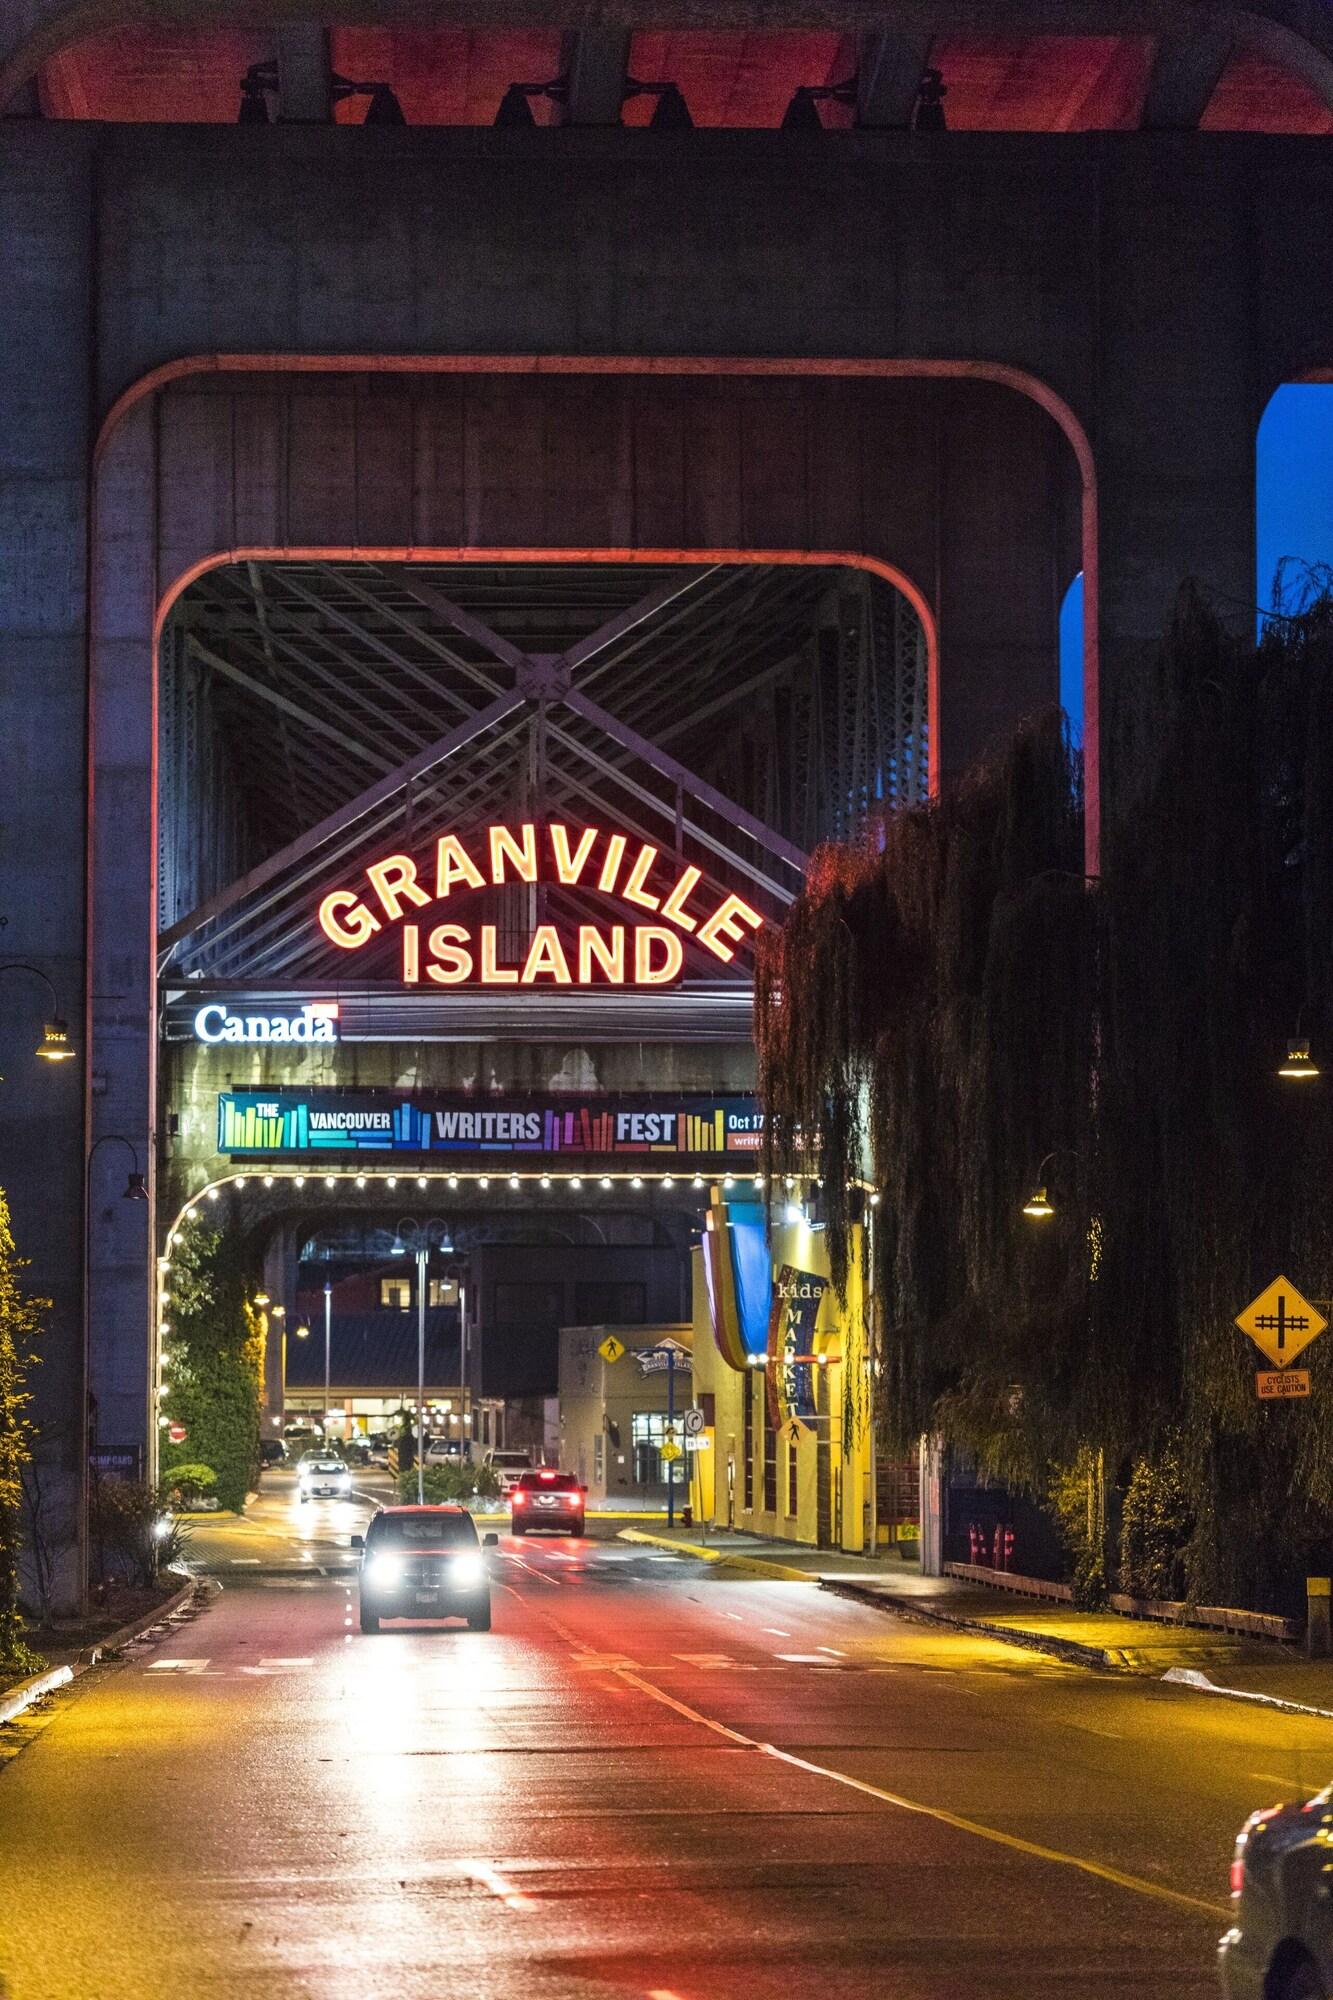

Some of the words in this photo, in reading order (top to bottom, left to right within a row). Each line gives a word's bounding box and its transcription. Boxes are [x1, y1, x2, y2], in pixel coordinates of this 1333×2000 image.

[318, 823, 765, 964] GRANVILLE
[402, 924, 683, 985] ISLAND
[194, 1005, 338, 1044] Canada
[256, 1103, 279, 1118] THE
[309, 1112, 391, 1130] VANCOUVER
[436, 1111, 541, 1140] WRITERS
[616, 1113, 676, 1142] FEST
[728, 1115, 750, 1129] Oct
[778, 1283, 822, 1298] kids
[1261, 1385, 1274, 1394] USE
[1277, 1384, 1306, 1393] CAUTION
[1267, 1375, 1300, 1385] CYCLISTS
